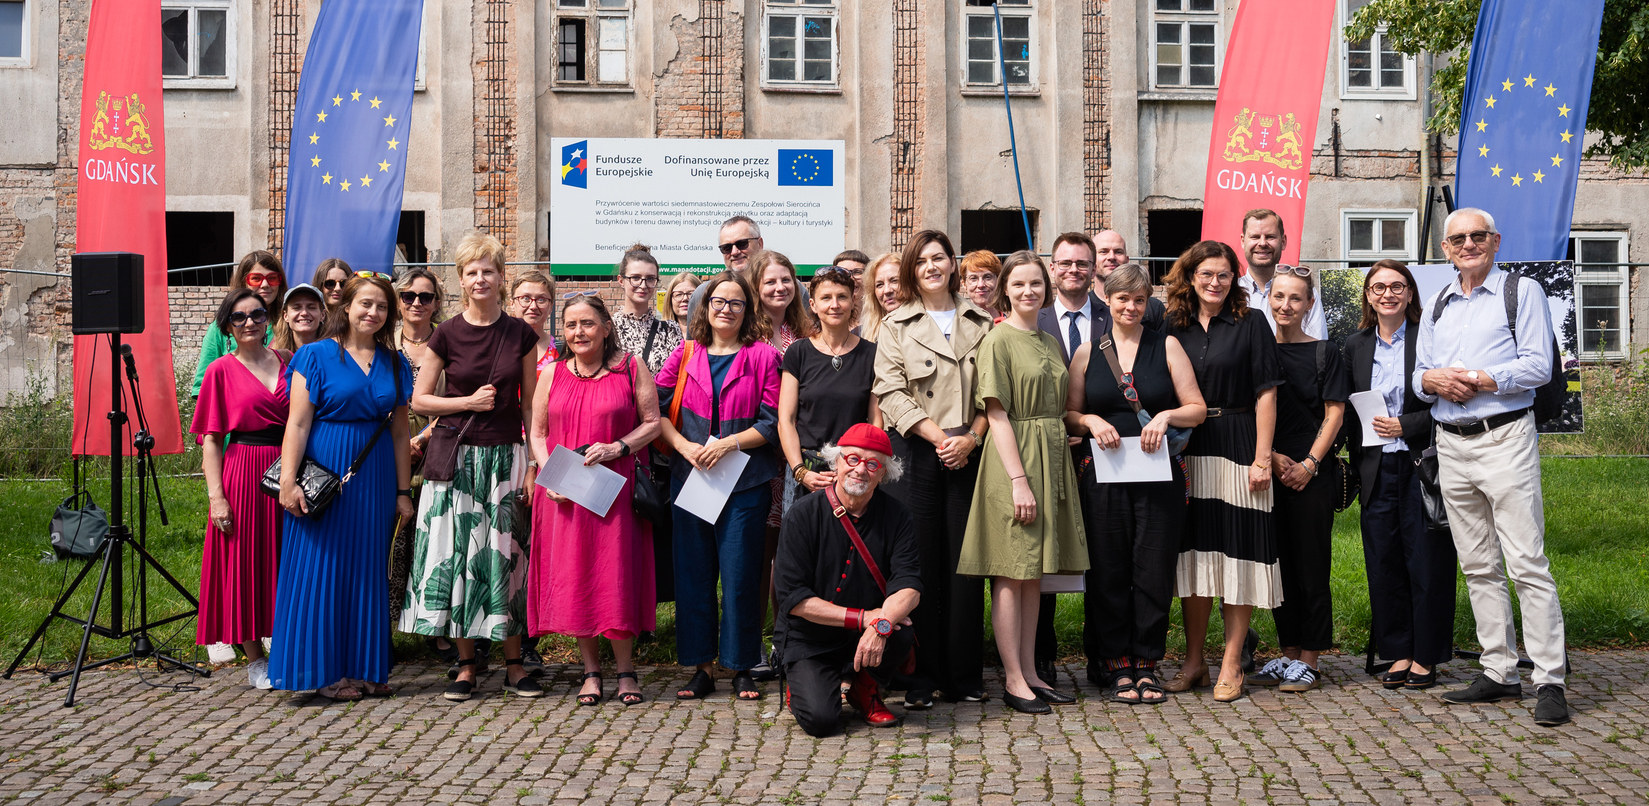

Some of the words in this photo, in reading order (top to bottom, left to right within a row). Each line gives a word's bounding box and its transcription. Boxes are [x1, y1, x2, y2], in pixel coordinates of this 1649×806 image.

[595, 155, 642, 164] Fundusze
[664, 155, 740, 165] Dofinansowane
[743, 157, 769, 166] przez
[85, 157, 158, 185] GDAŃSK
[595, 167, 653, 178] Europejskie
[690, 168, 713, 179] Unię
[715, 168, 770, 180] Europejską
[1217, 171, 1302, 199] GDAŃSK
[595, 200, 640, 208] Przywrócenie
[671, 200, 749, 208] siedemnastowiecznemu
[751, 200, 784, 209] Zespołowi
[786, 200, 821, 208] Sierocińca
[641, 209, 682, 217] konserwacją
[687, 209, 731, 218] rekonstrukcją
[776, 210, 808, 218] adaptacją
[595, 218, 629, 226] budynków
[657, 218, 681, 226] dawnej
[683, 218, 711, 227] instytucji
[756, 219, 771, 227] nkcji
[779, 219, 800, 227] kultury
[806, 219, 833, 227] turystyki
[660, 243, 682, 251] Miasta
[684, 243, 714, 251] Gdańska
